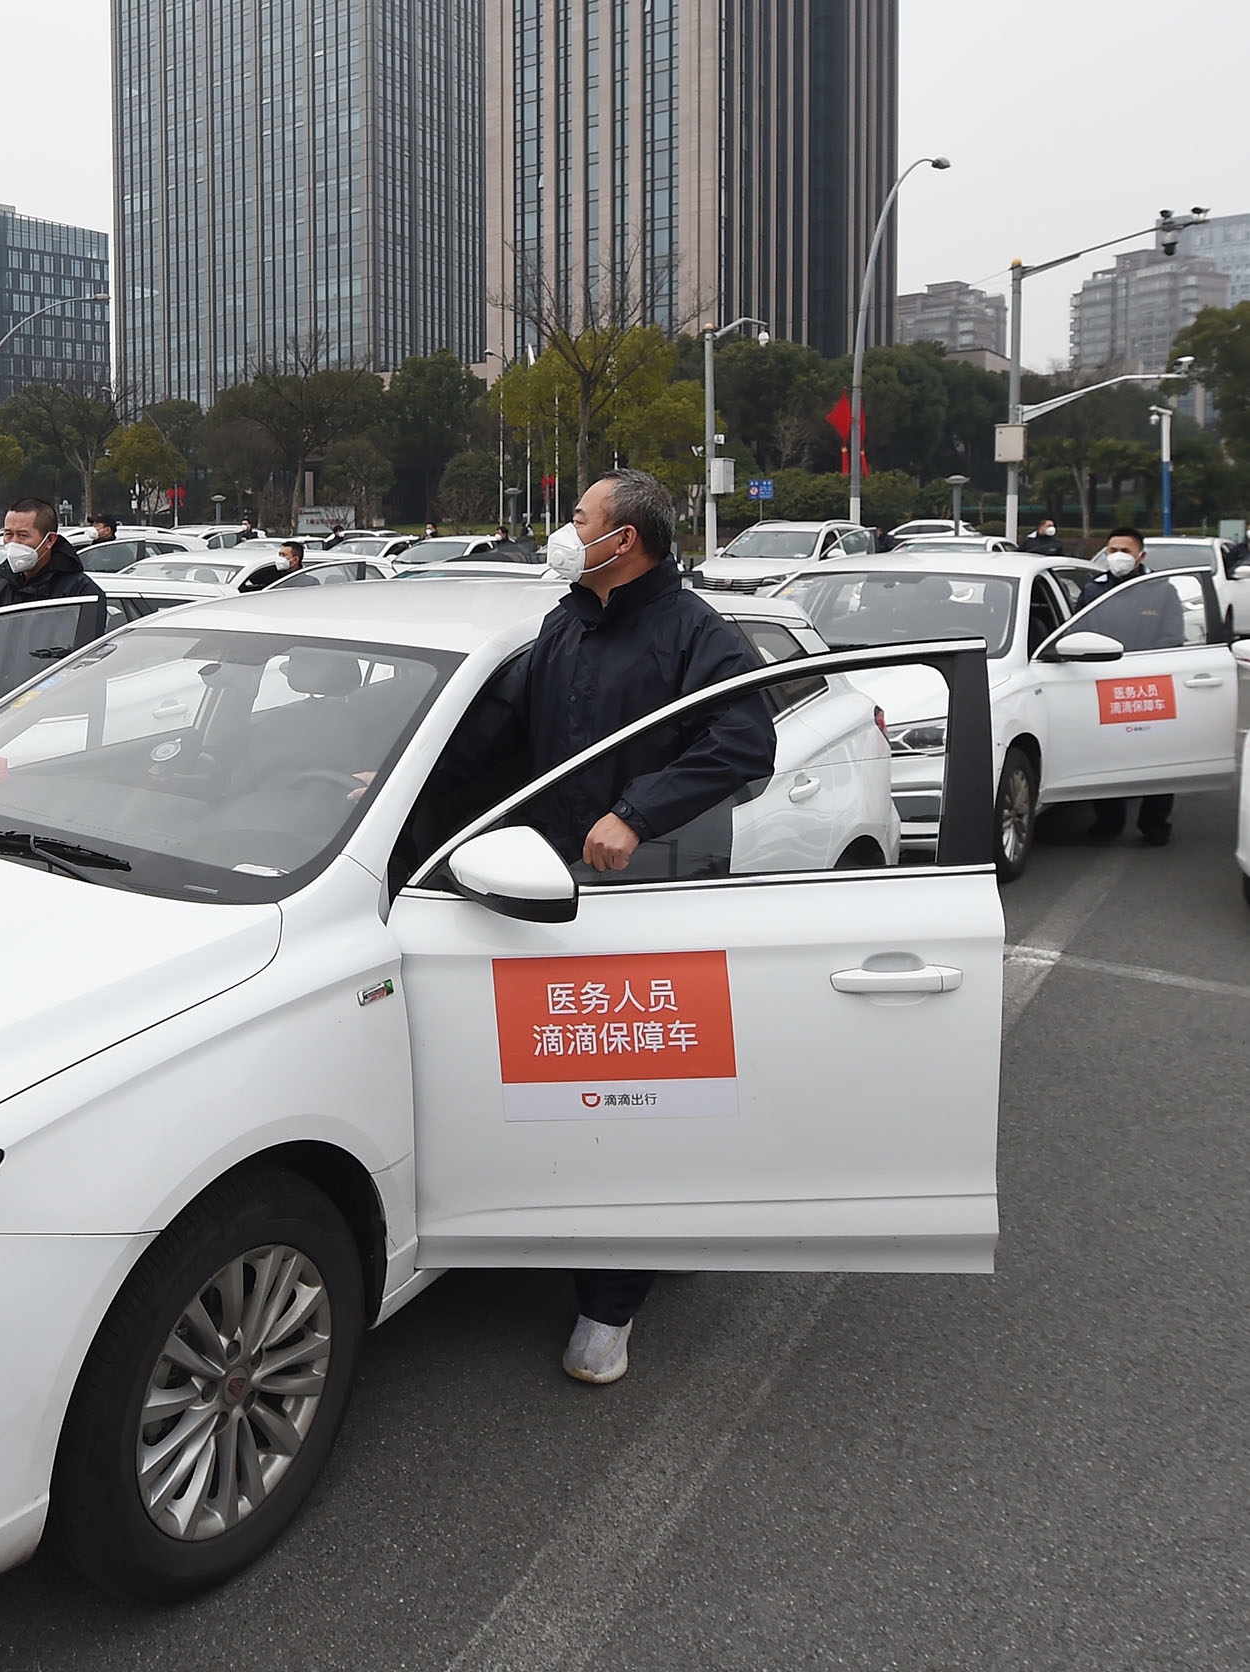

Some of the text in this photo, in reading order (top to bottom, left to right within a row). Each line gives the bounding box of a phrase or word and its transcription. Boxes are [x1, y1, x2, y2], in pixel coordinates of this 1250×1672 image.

[1114, 684, 1158, 699] 医务人员
[1110, 699, 1165, 713] 滴滴保障车
[546, 979, 679, 1015] 医务人员
[532, 1020, 699, 1057] 滴滴保障车
[604, 1093, 658, 1106] 滴滴出行
